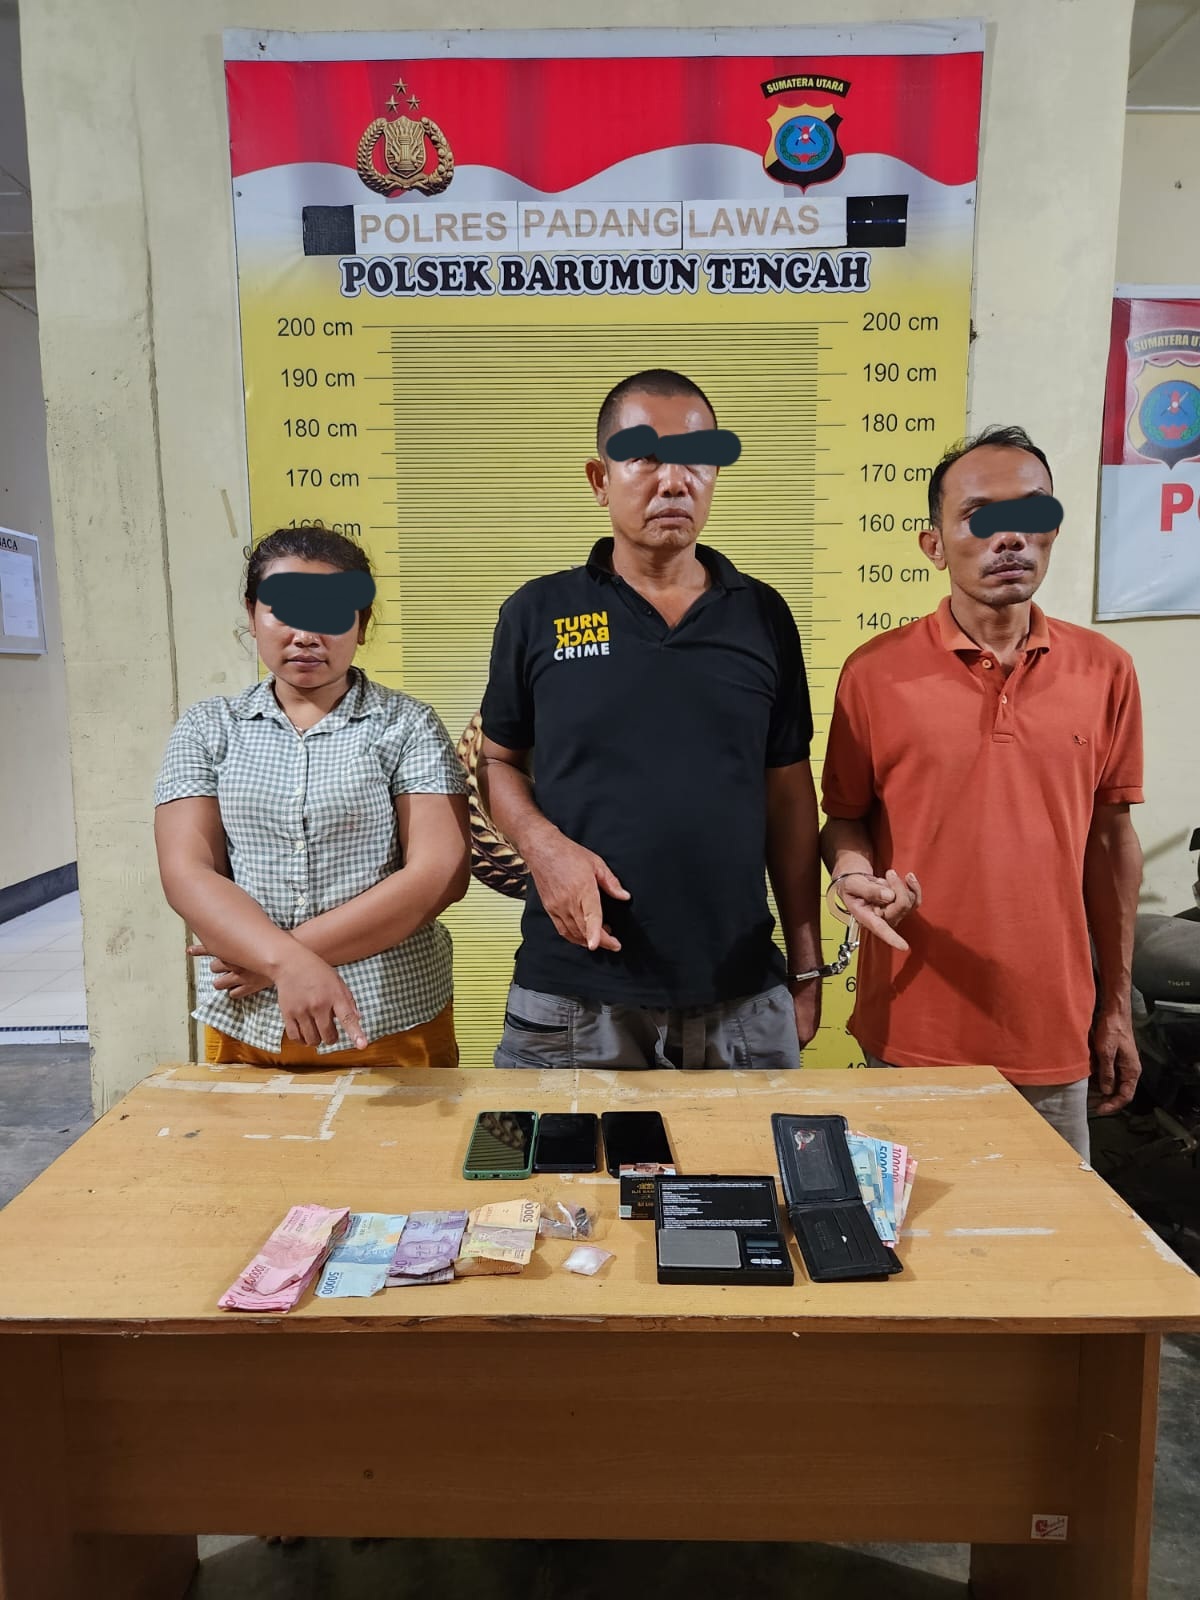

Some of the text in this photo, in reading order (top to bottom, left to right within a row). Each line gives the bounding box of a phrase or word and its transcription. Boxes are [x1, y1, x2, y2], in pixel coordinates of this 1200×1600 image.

[766, 78, 844, 94] SUMATERA UTARA
[360, 205, 820, 244] POLRES PADANG LAWAS
[341, 256, 868, 294] POLSEK BARUMUN TENGAH
[277, 317, 353, 337] 200 cm
[862, 312, 938, 331] 200 cm
[1133, 335, 1189, 352] SUMATERA
[281, 368, 355, 388] 190 cm
[863, 363, 937, 382] 190 cm
[283, 418, 357, 438] 180 cm
[861, 413, 935, 432] 180 cm
[286, 468, 359, 487] 170 cm
[860, 463, 932, 482] 170 cm
[858, 513, 932, 532] 160 cm
[0, 537, 18, 551] ACA
[857, 564, 930, 583] 150 cm
[553, 610, 609, 634] TURN
[856, 612, 892, 630] 140
[553, 642, 610, 661] CRIME
[321, 1271, 340, 1295] 50000
